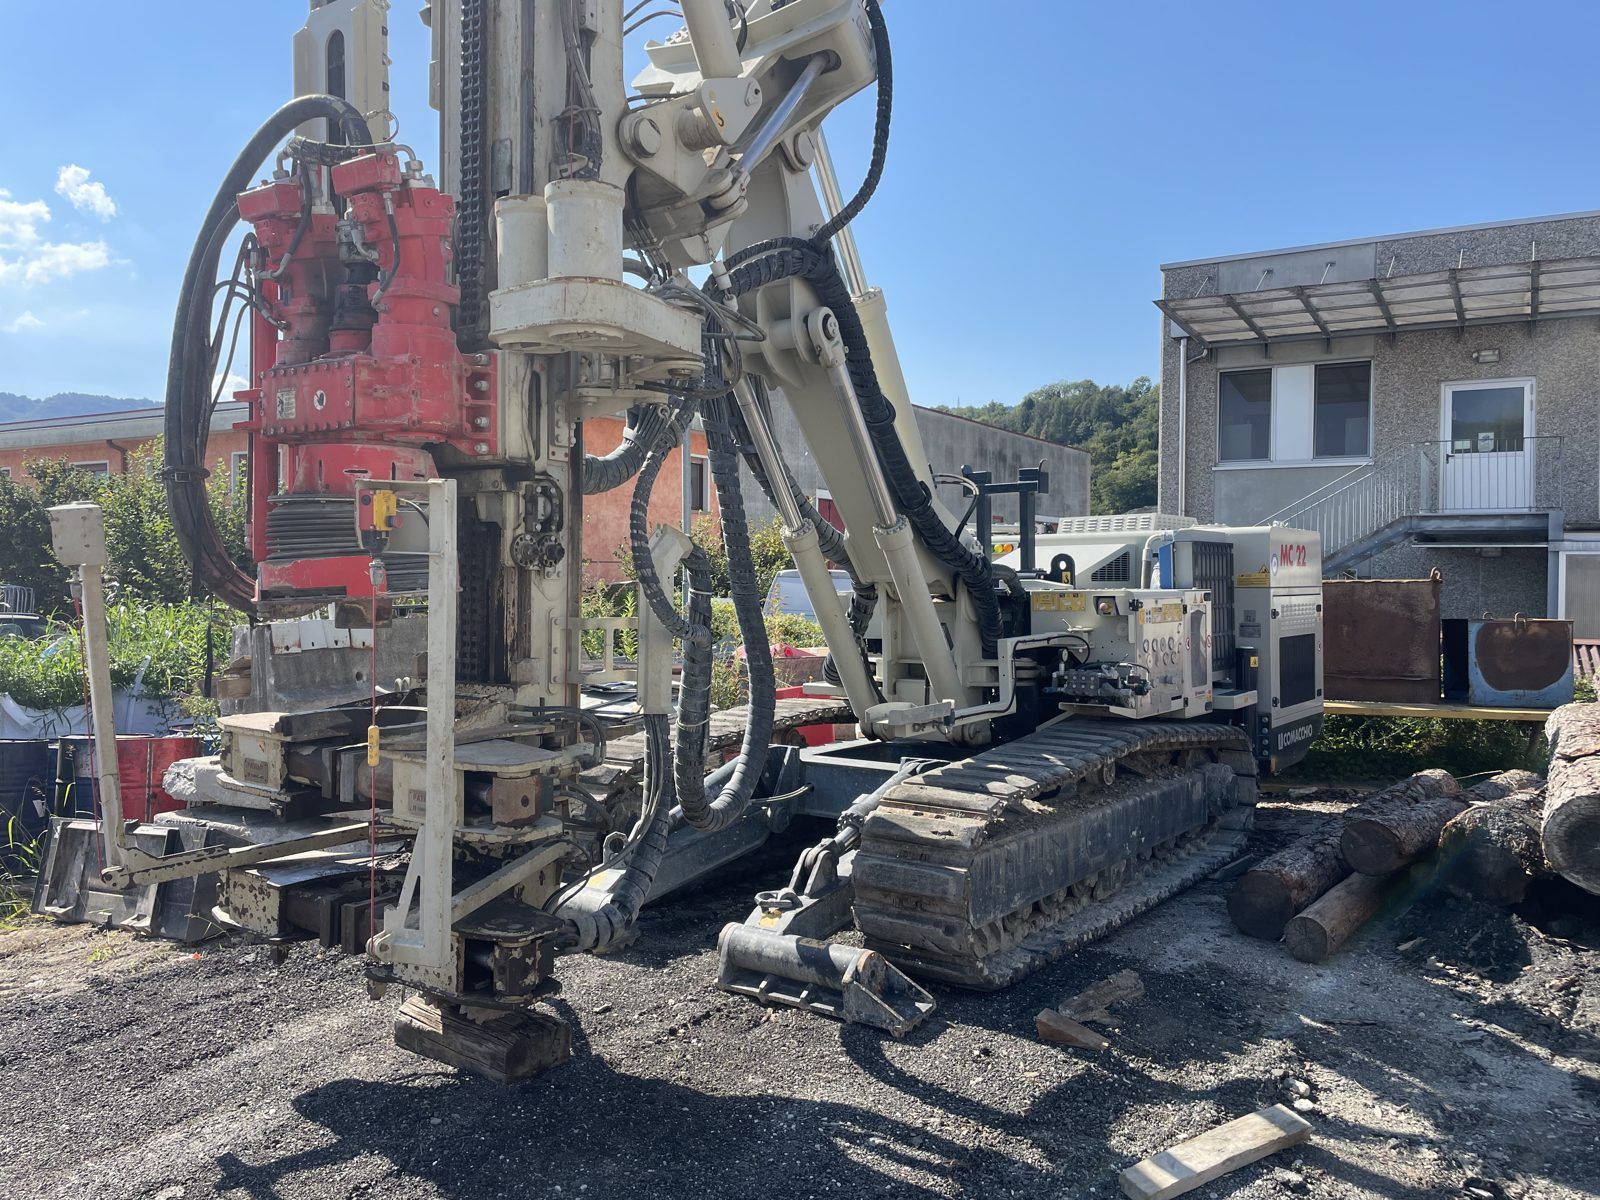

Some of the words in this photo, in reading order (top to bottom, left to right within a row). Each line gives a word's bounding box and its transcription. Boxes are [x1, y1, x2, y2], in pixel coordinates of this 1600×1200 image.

[1280, 544, 1294, 566] MC
[1296, 544, 1307, 566] 22
[1284, 724, 1313, 746] COMACCHIO
